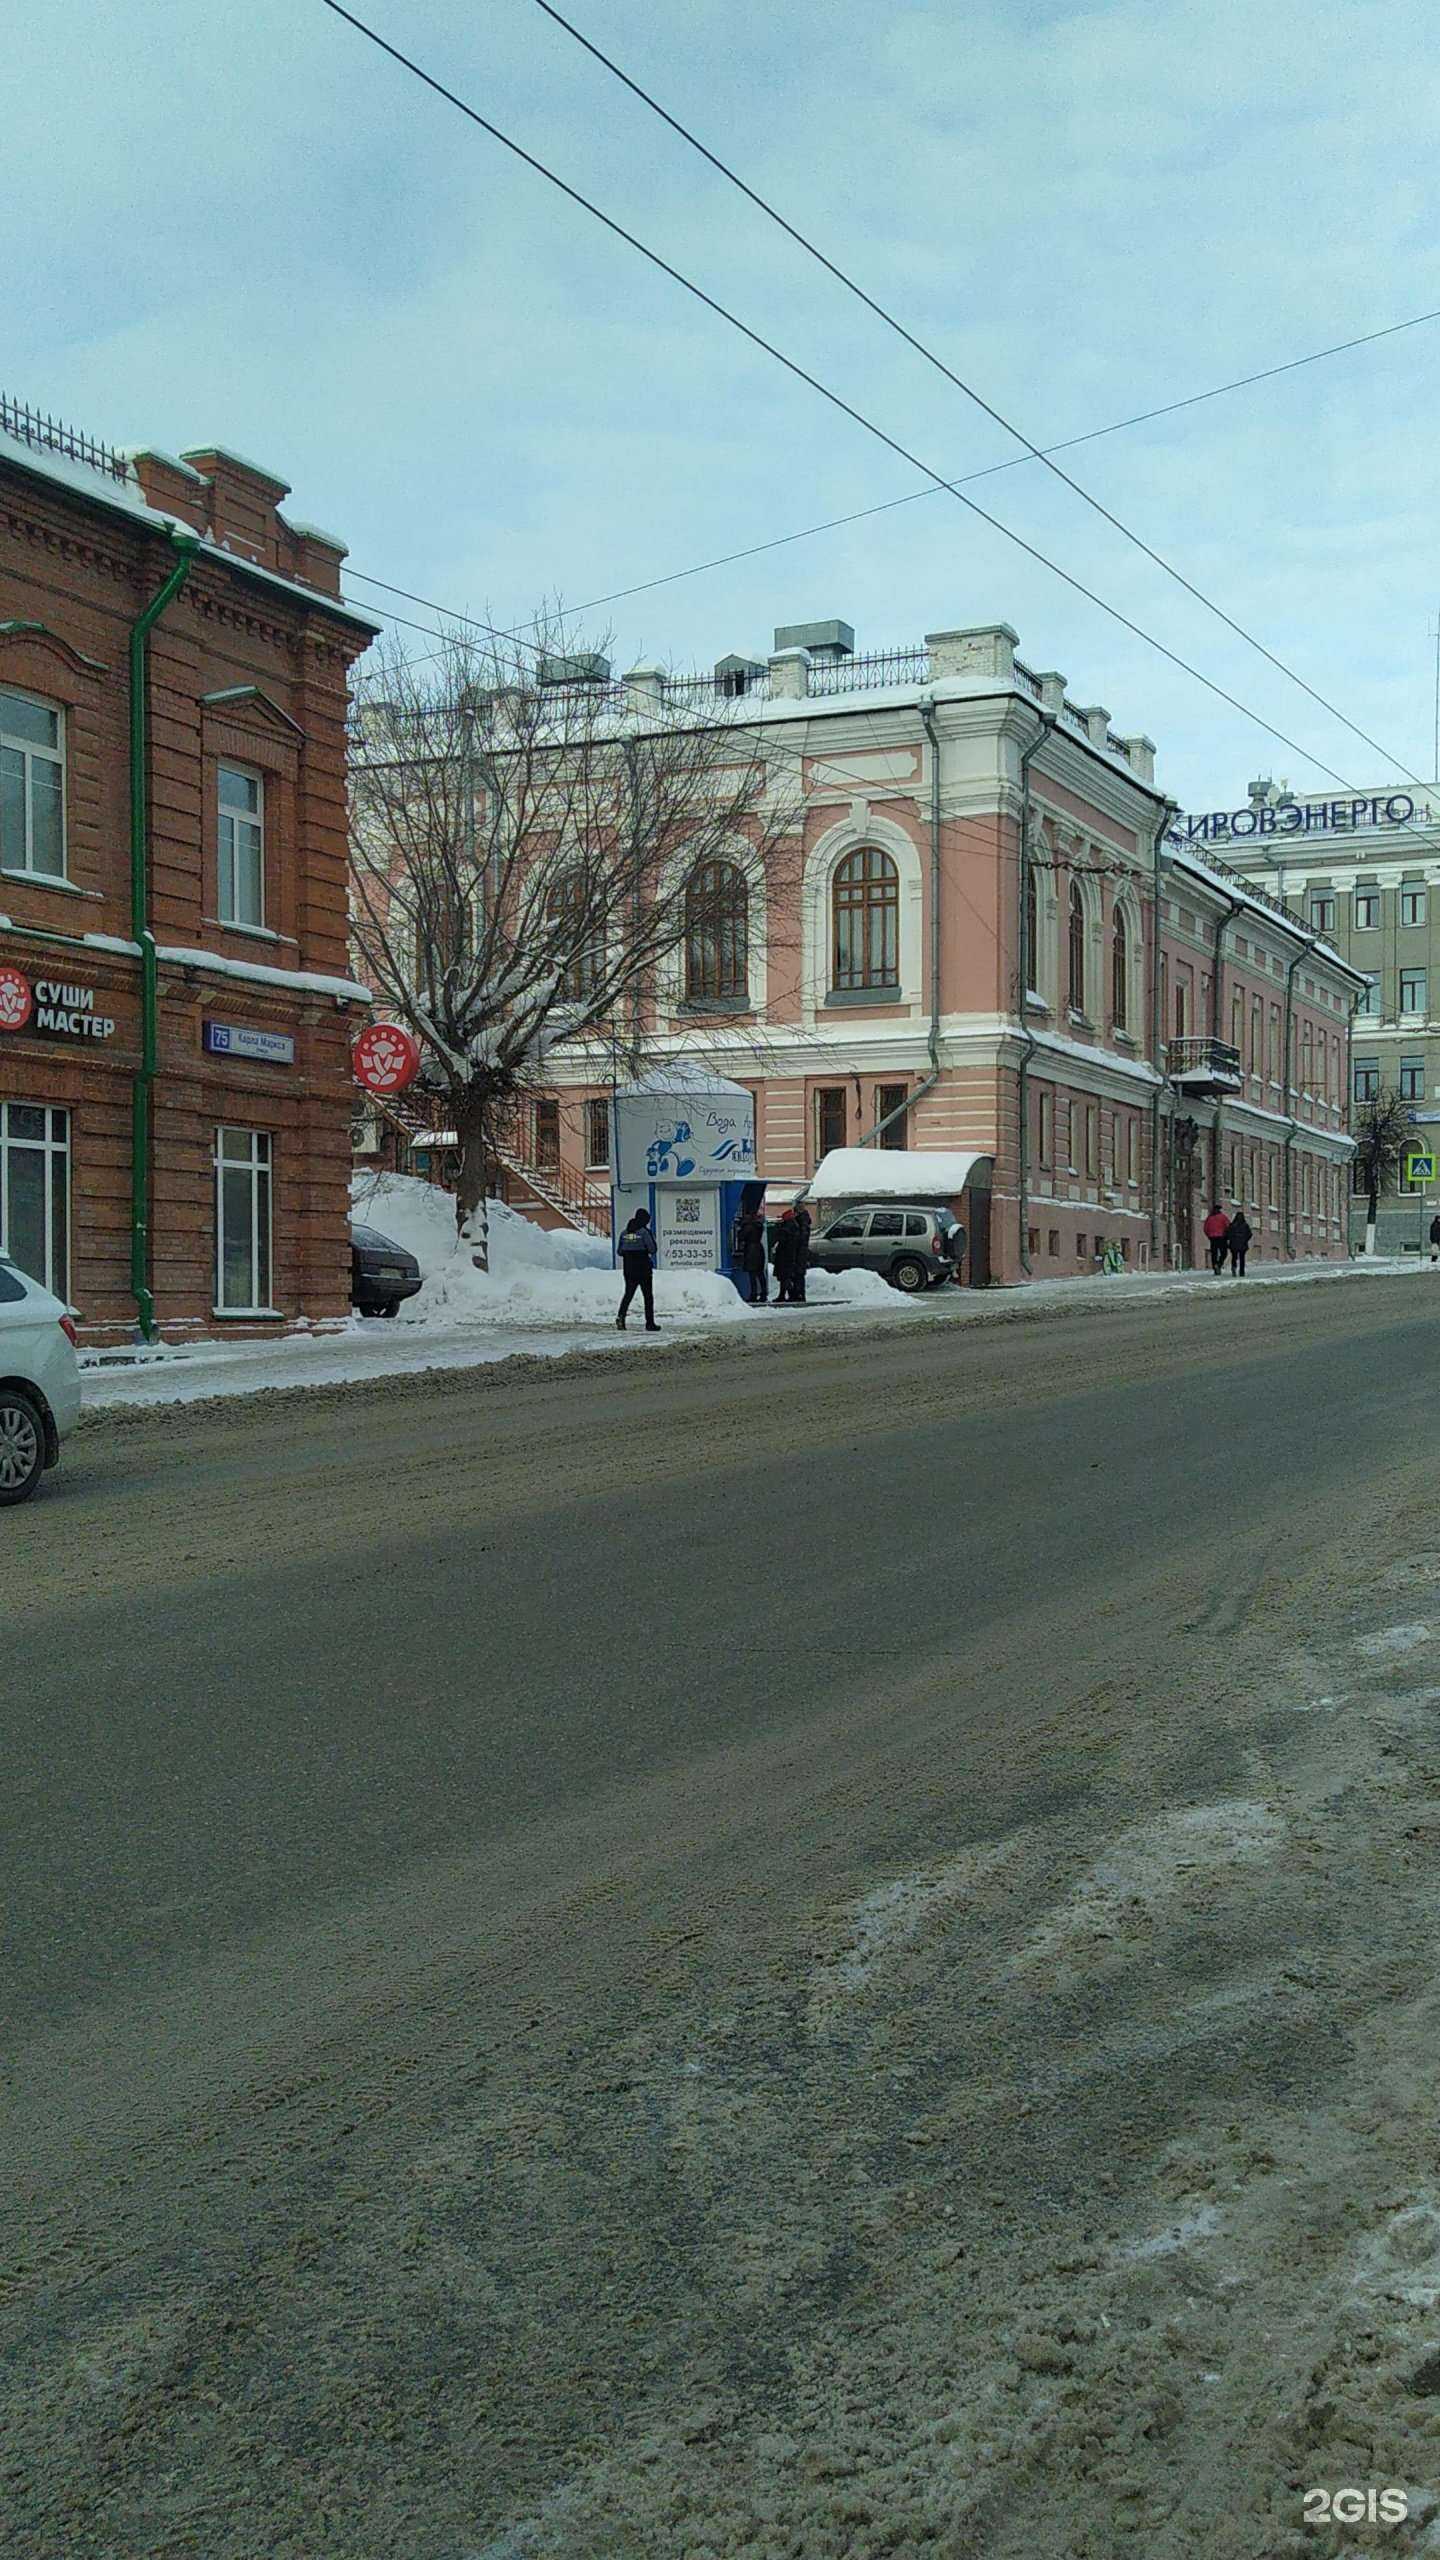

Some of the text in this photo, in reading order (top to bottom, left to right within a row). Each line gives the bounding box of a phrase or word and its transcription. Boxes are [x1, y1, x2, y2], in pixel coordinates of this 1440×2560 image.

[35, 981, 94, 1010] СУШИ
[37, 1007, 115, 1038] МАСТЕР
[215, 1029, 229, 1046] 75
